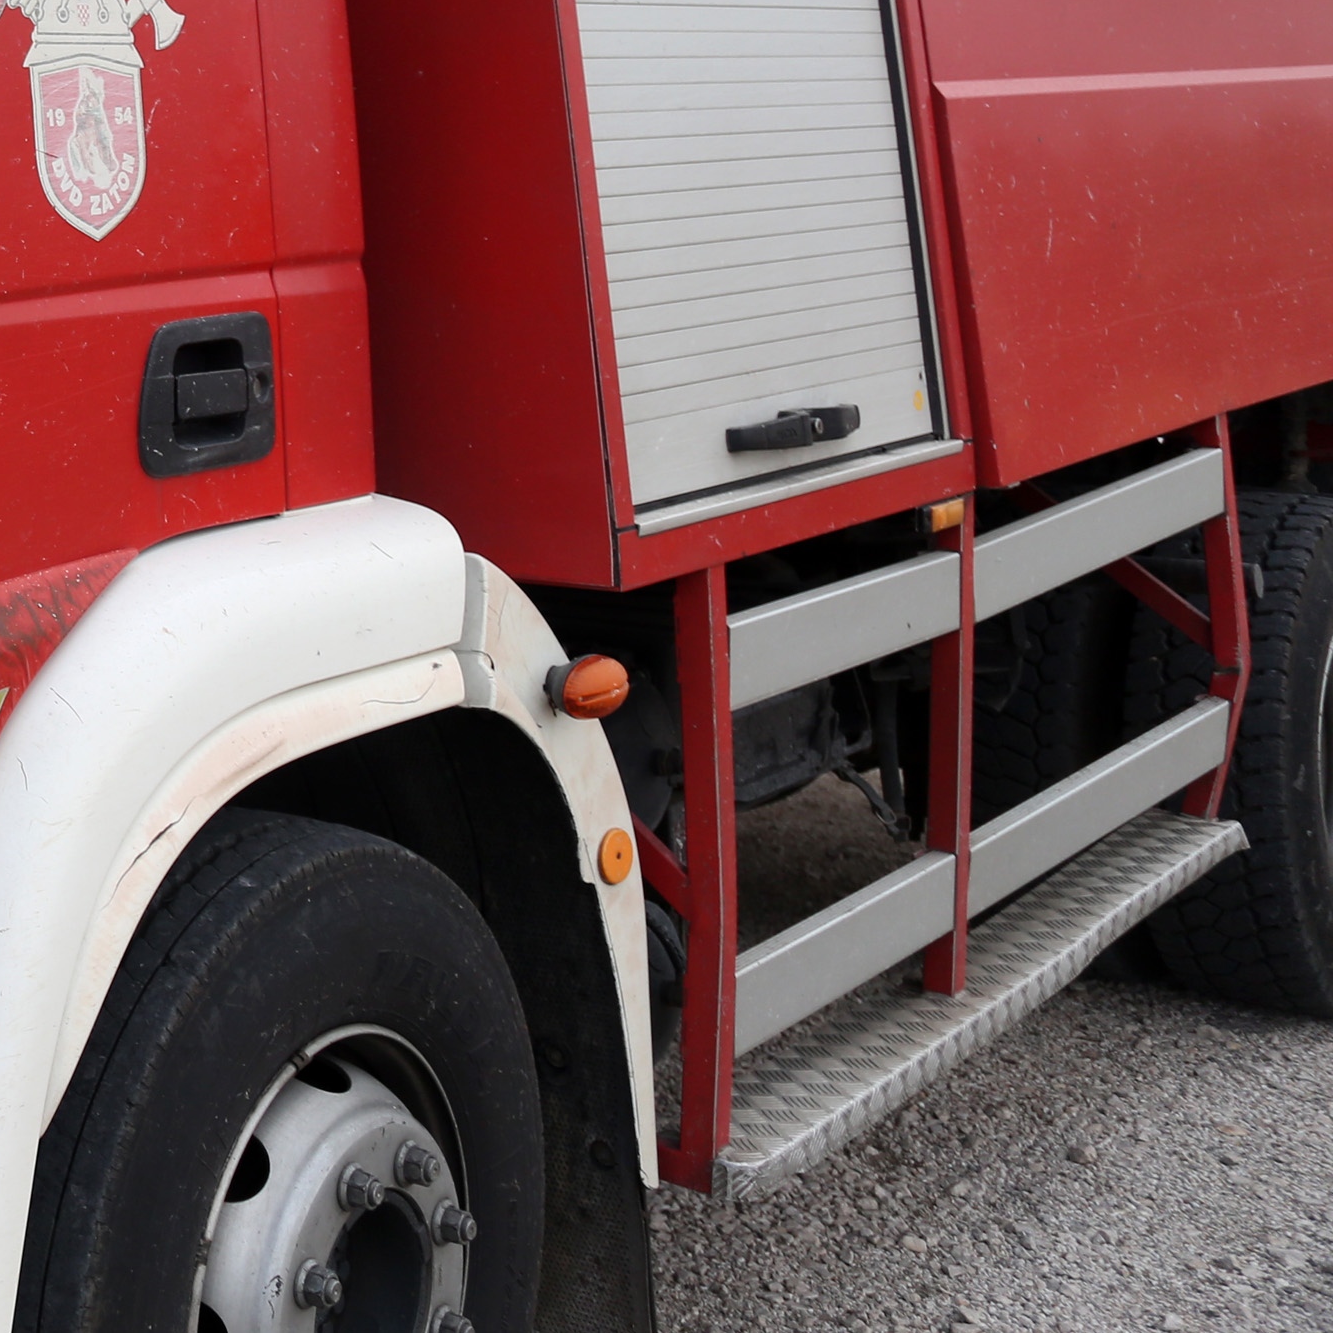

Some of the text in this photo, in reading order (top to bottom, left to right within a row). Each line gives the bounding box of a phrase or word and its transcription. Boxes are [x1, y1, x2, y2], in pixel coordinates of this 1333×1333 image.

[46, 106, 133, 127] 19 54
[52, 153, 136, 216] DVD ZATON
